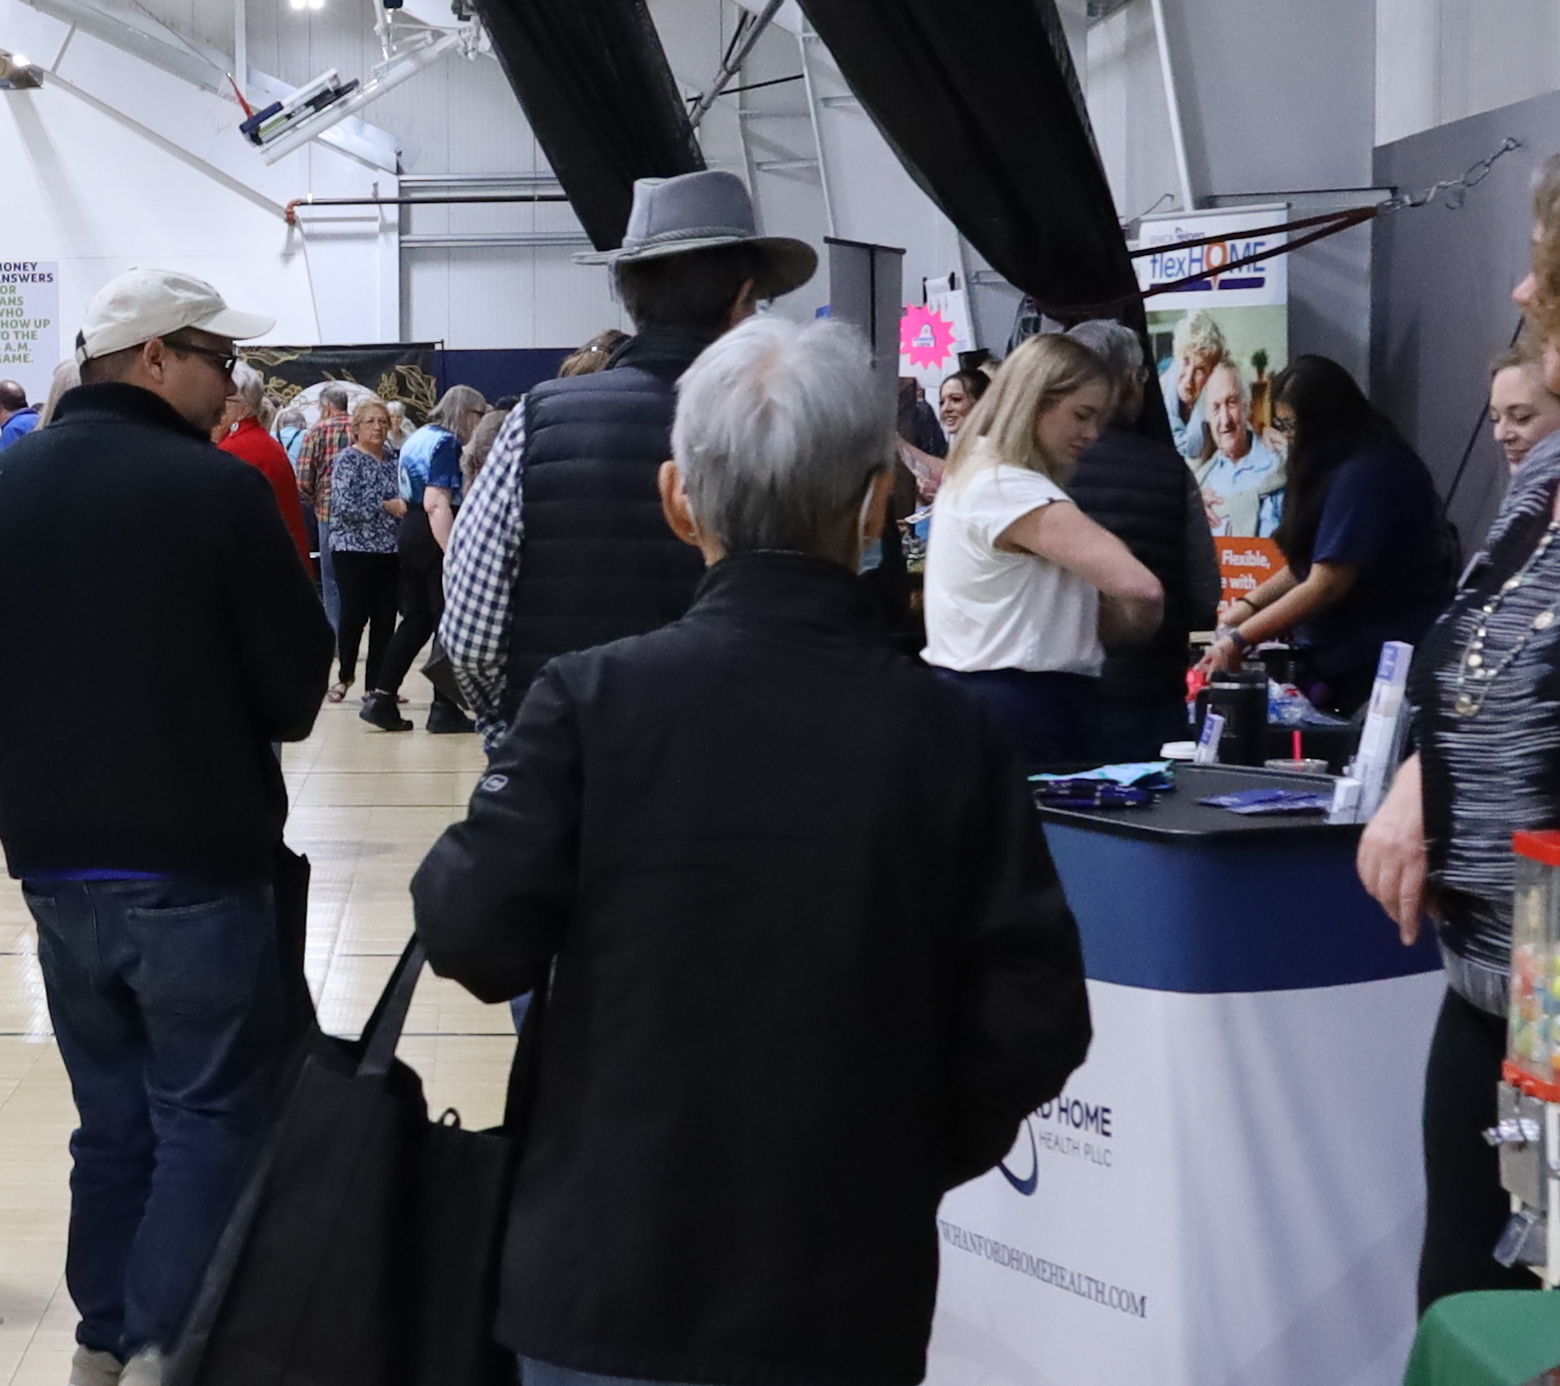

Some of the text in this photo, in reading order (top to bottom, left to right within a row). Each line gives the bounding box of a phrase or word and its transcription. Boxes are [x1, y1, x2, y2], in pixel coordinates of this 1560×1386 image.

[34, 319, 51, 329] UP
[13, 330, 38, 340] THE
[4, 342, 32, 352] A.M.
[1222, 548, 1271, 569] Flexible,
[1230, 573, 1256, 589] with
[1058, 1096, 1113, 1137] HOME
[1039, 1131, 1112, 1167] HEALTH PLLC
